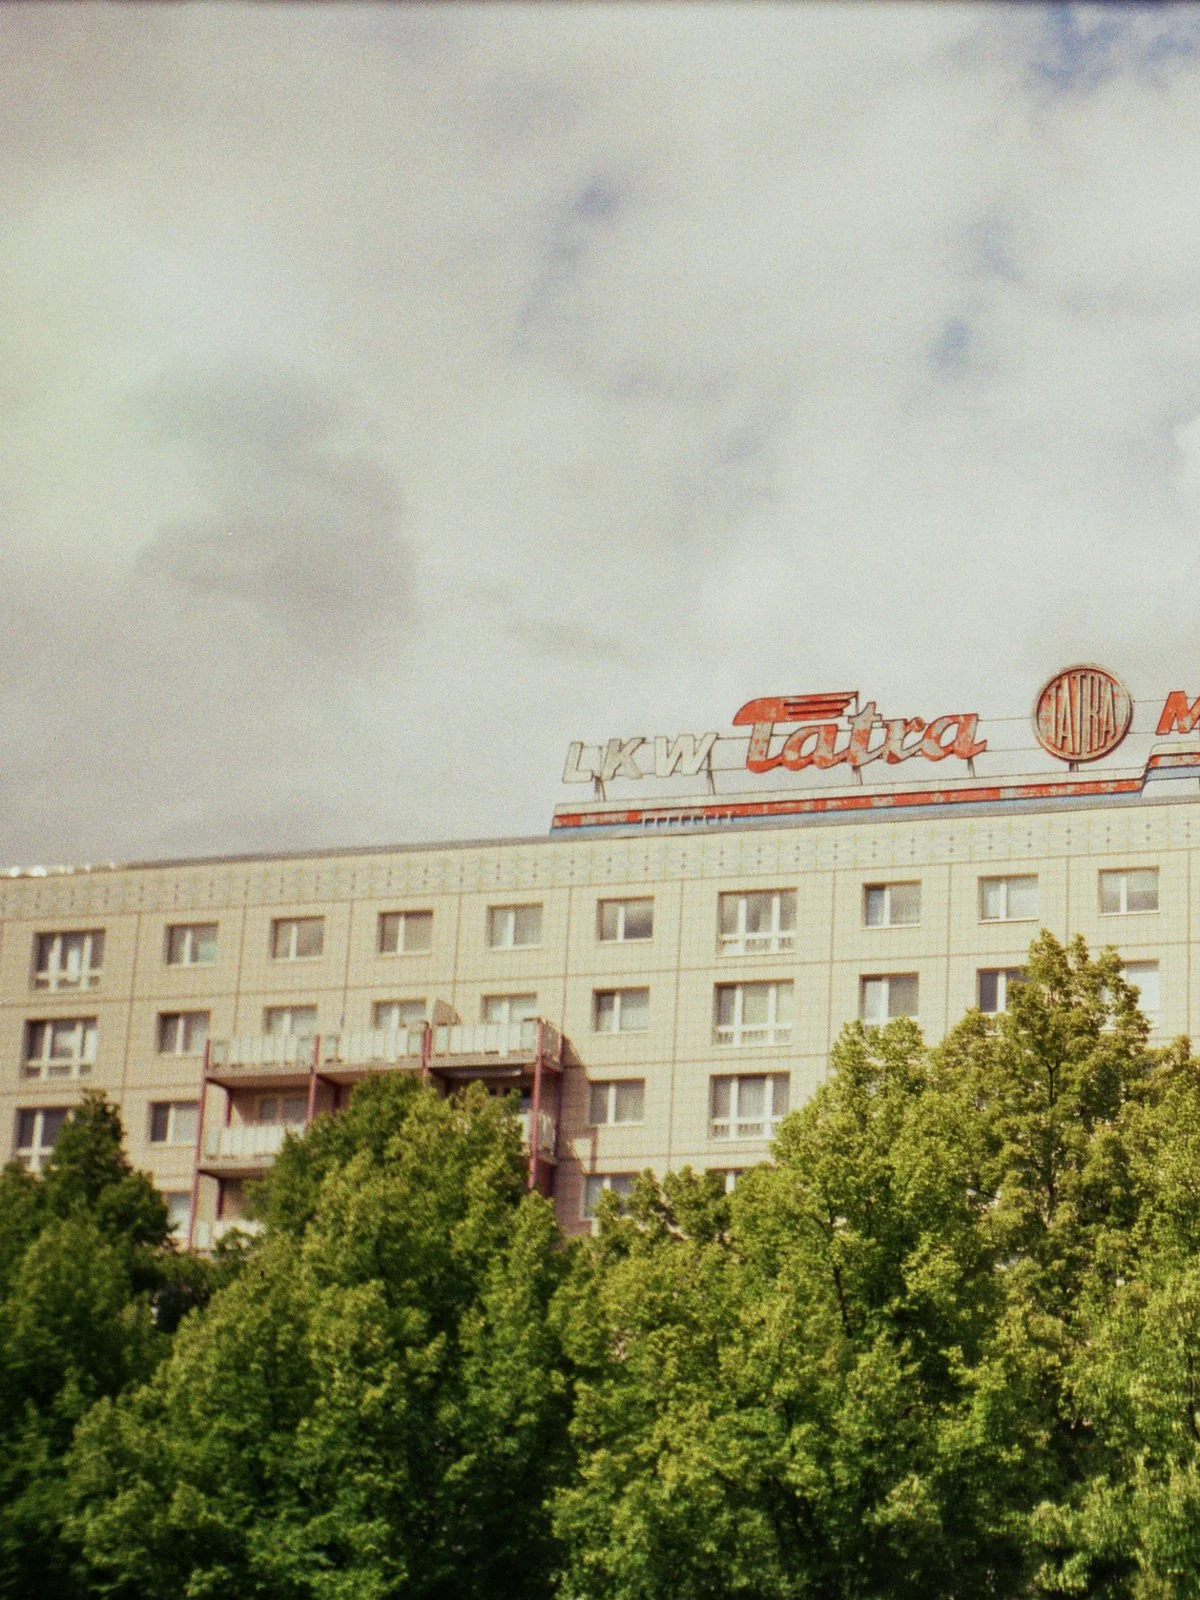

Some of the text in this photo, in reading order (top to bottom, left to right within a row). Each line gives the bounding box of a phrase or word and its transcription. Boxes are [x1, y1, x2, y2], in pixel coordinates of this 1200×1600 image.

[562, 691, 987, 784] LKW Tatra
[1041, 673, 1119, 755] TATRA
